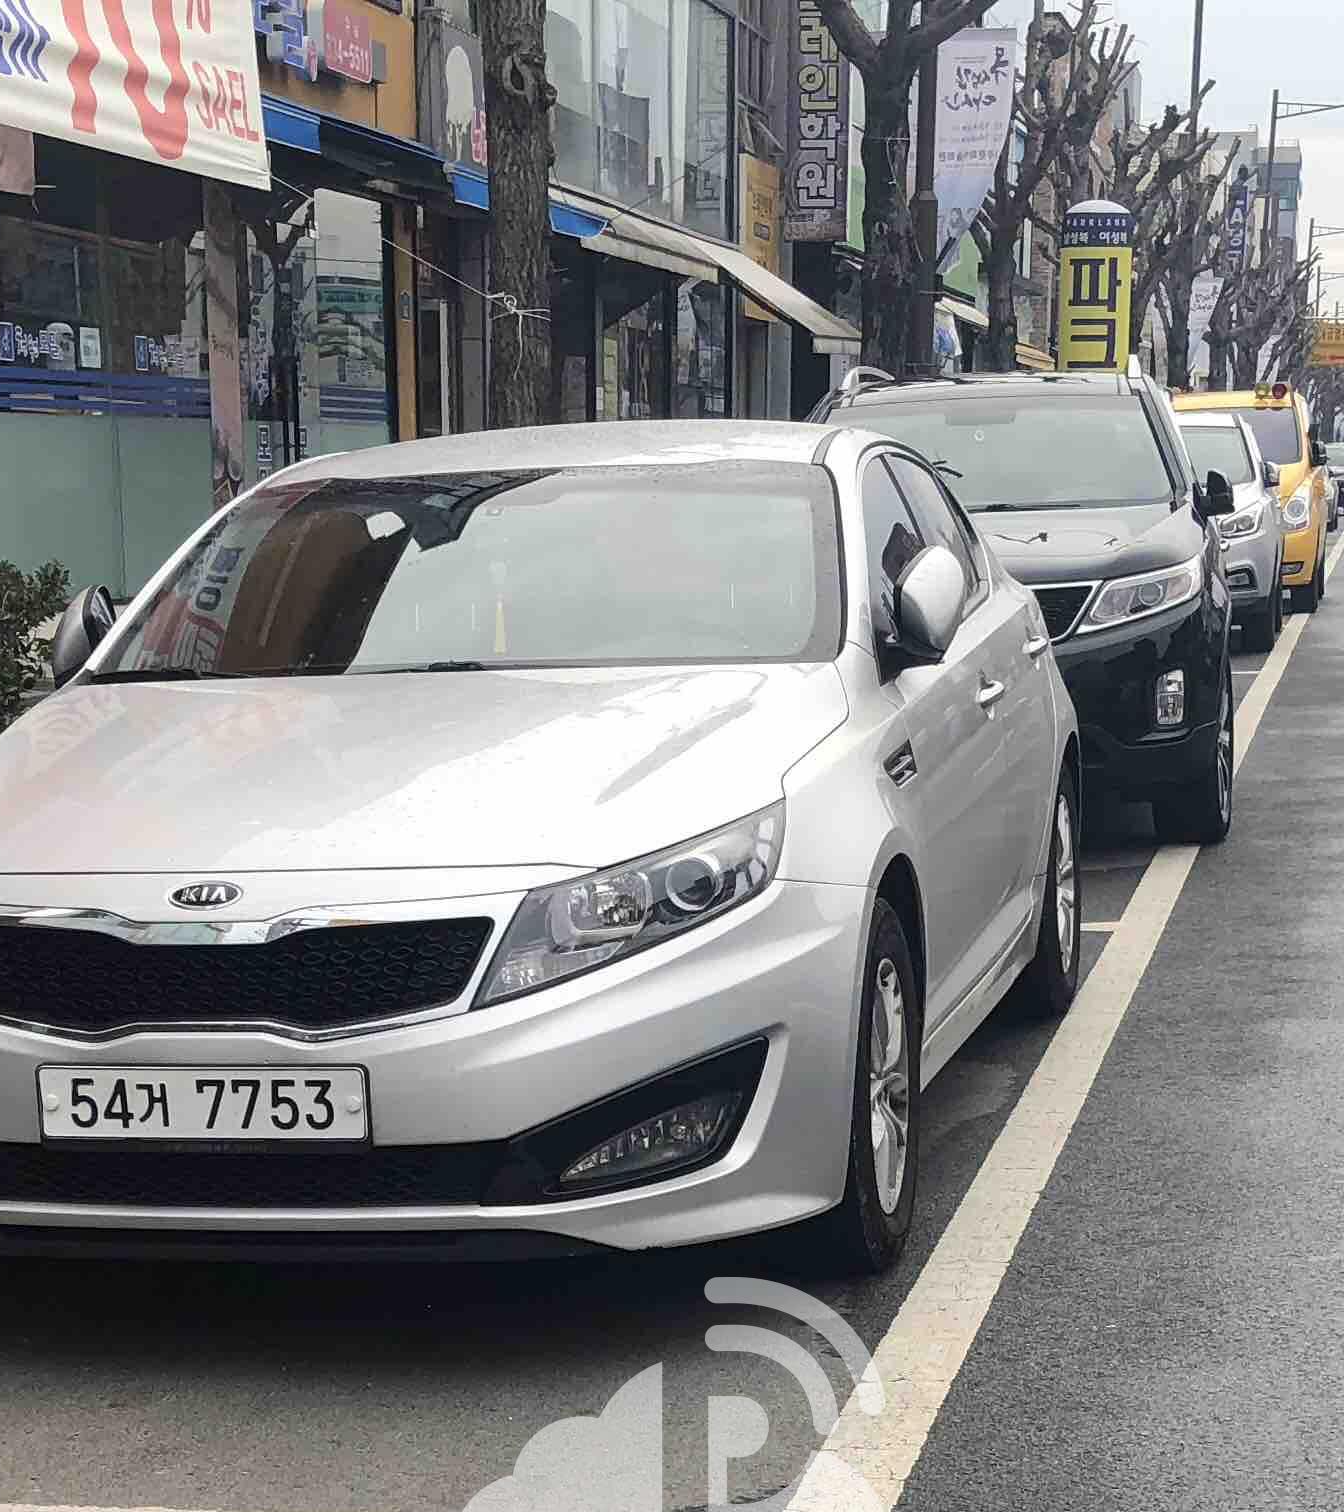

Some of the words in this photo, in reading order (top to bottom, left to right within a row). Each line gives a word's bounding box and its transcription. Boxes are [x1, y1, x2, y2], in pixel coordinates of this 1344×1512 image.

[797, 0, 842, 209] 레인학원
[1068, 257, 1122, 369] 파크
[194, 1078, 336, 1132] 7753
